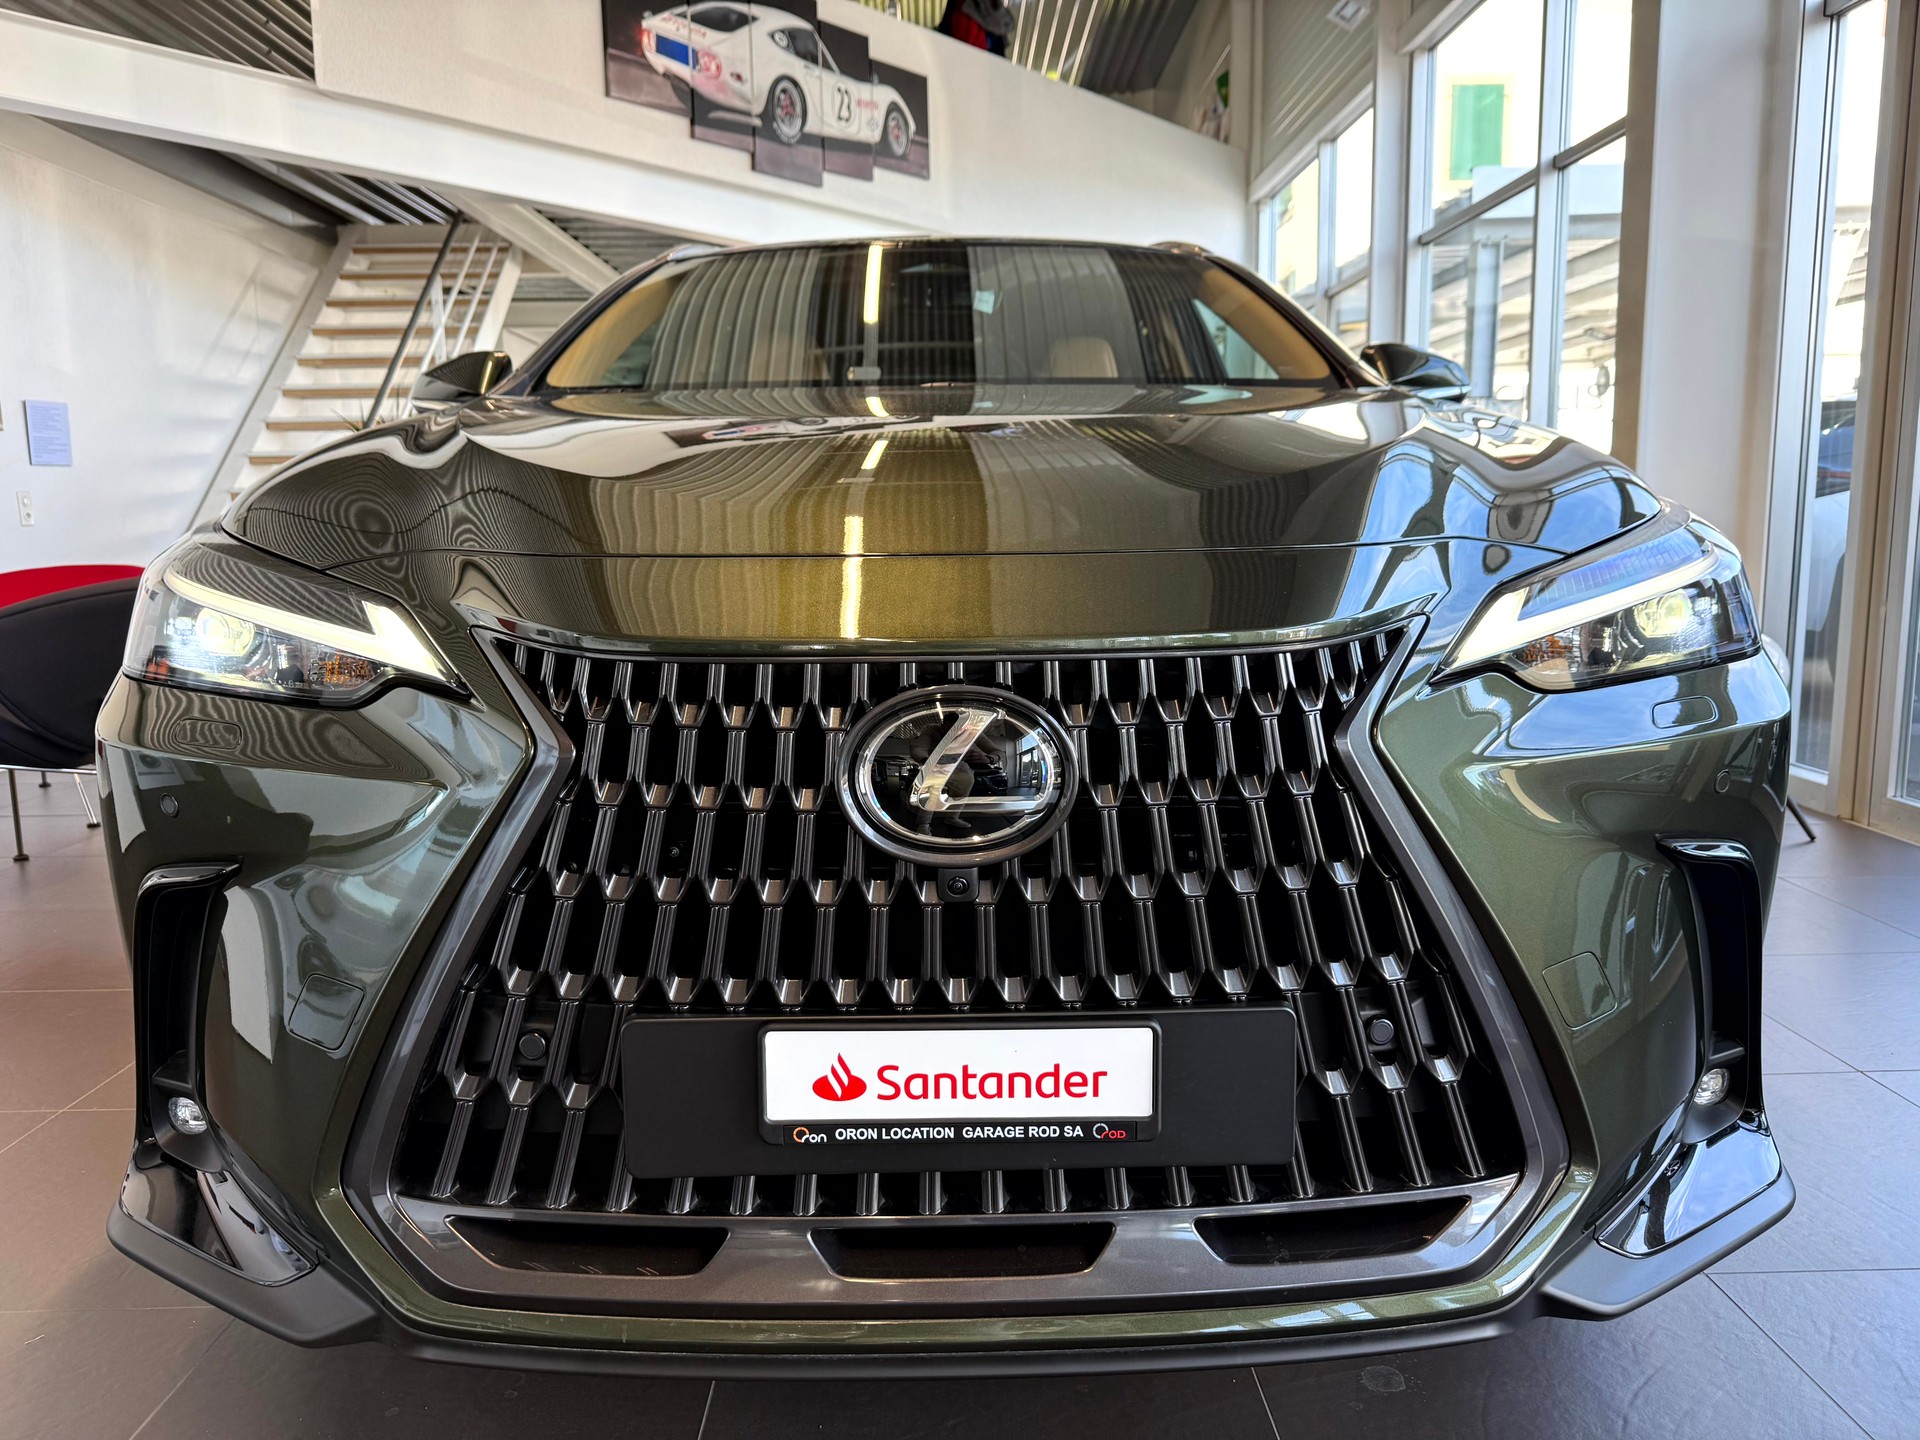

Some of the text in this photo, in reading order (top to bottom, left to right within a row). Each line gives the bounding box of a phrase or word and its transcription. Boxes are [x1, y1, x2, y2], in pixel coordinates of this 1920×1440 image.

[837, 86, 852, 122] 23
[877, 1064, 1107, 1100] Santander
[835, 1128, 877, 1140] ORON
[882, 1127, 954, 1139] LOCATION
[963, 1126, 1024, 1138] GARAGE
[1029, 1126, 1059, 1137] ROD
[1064, 1126, 1083, 1137] SA
